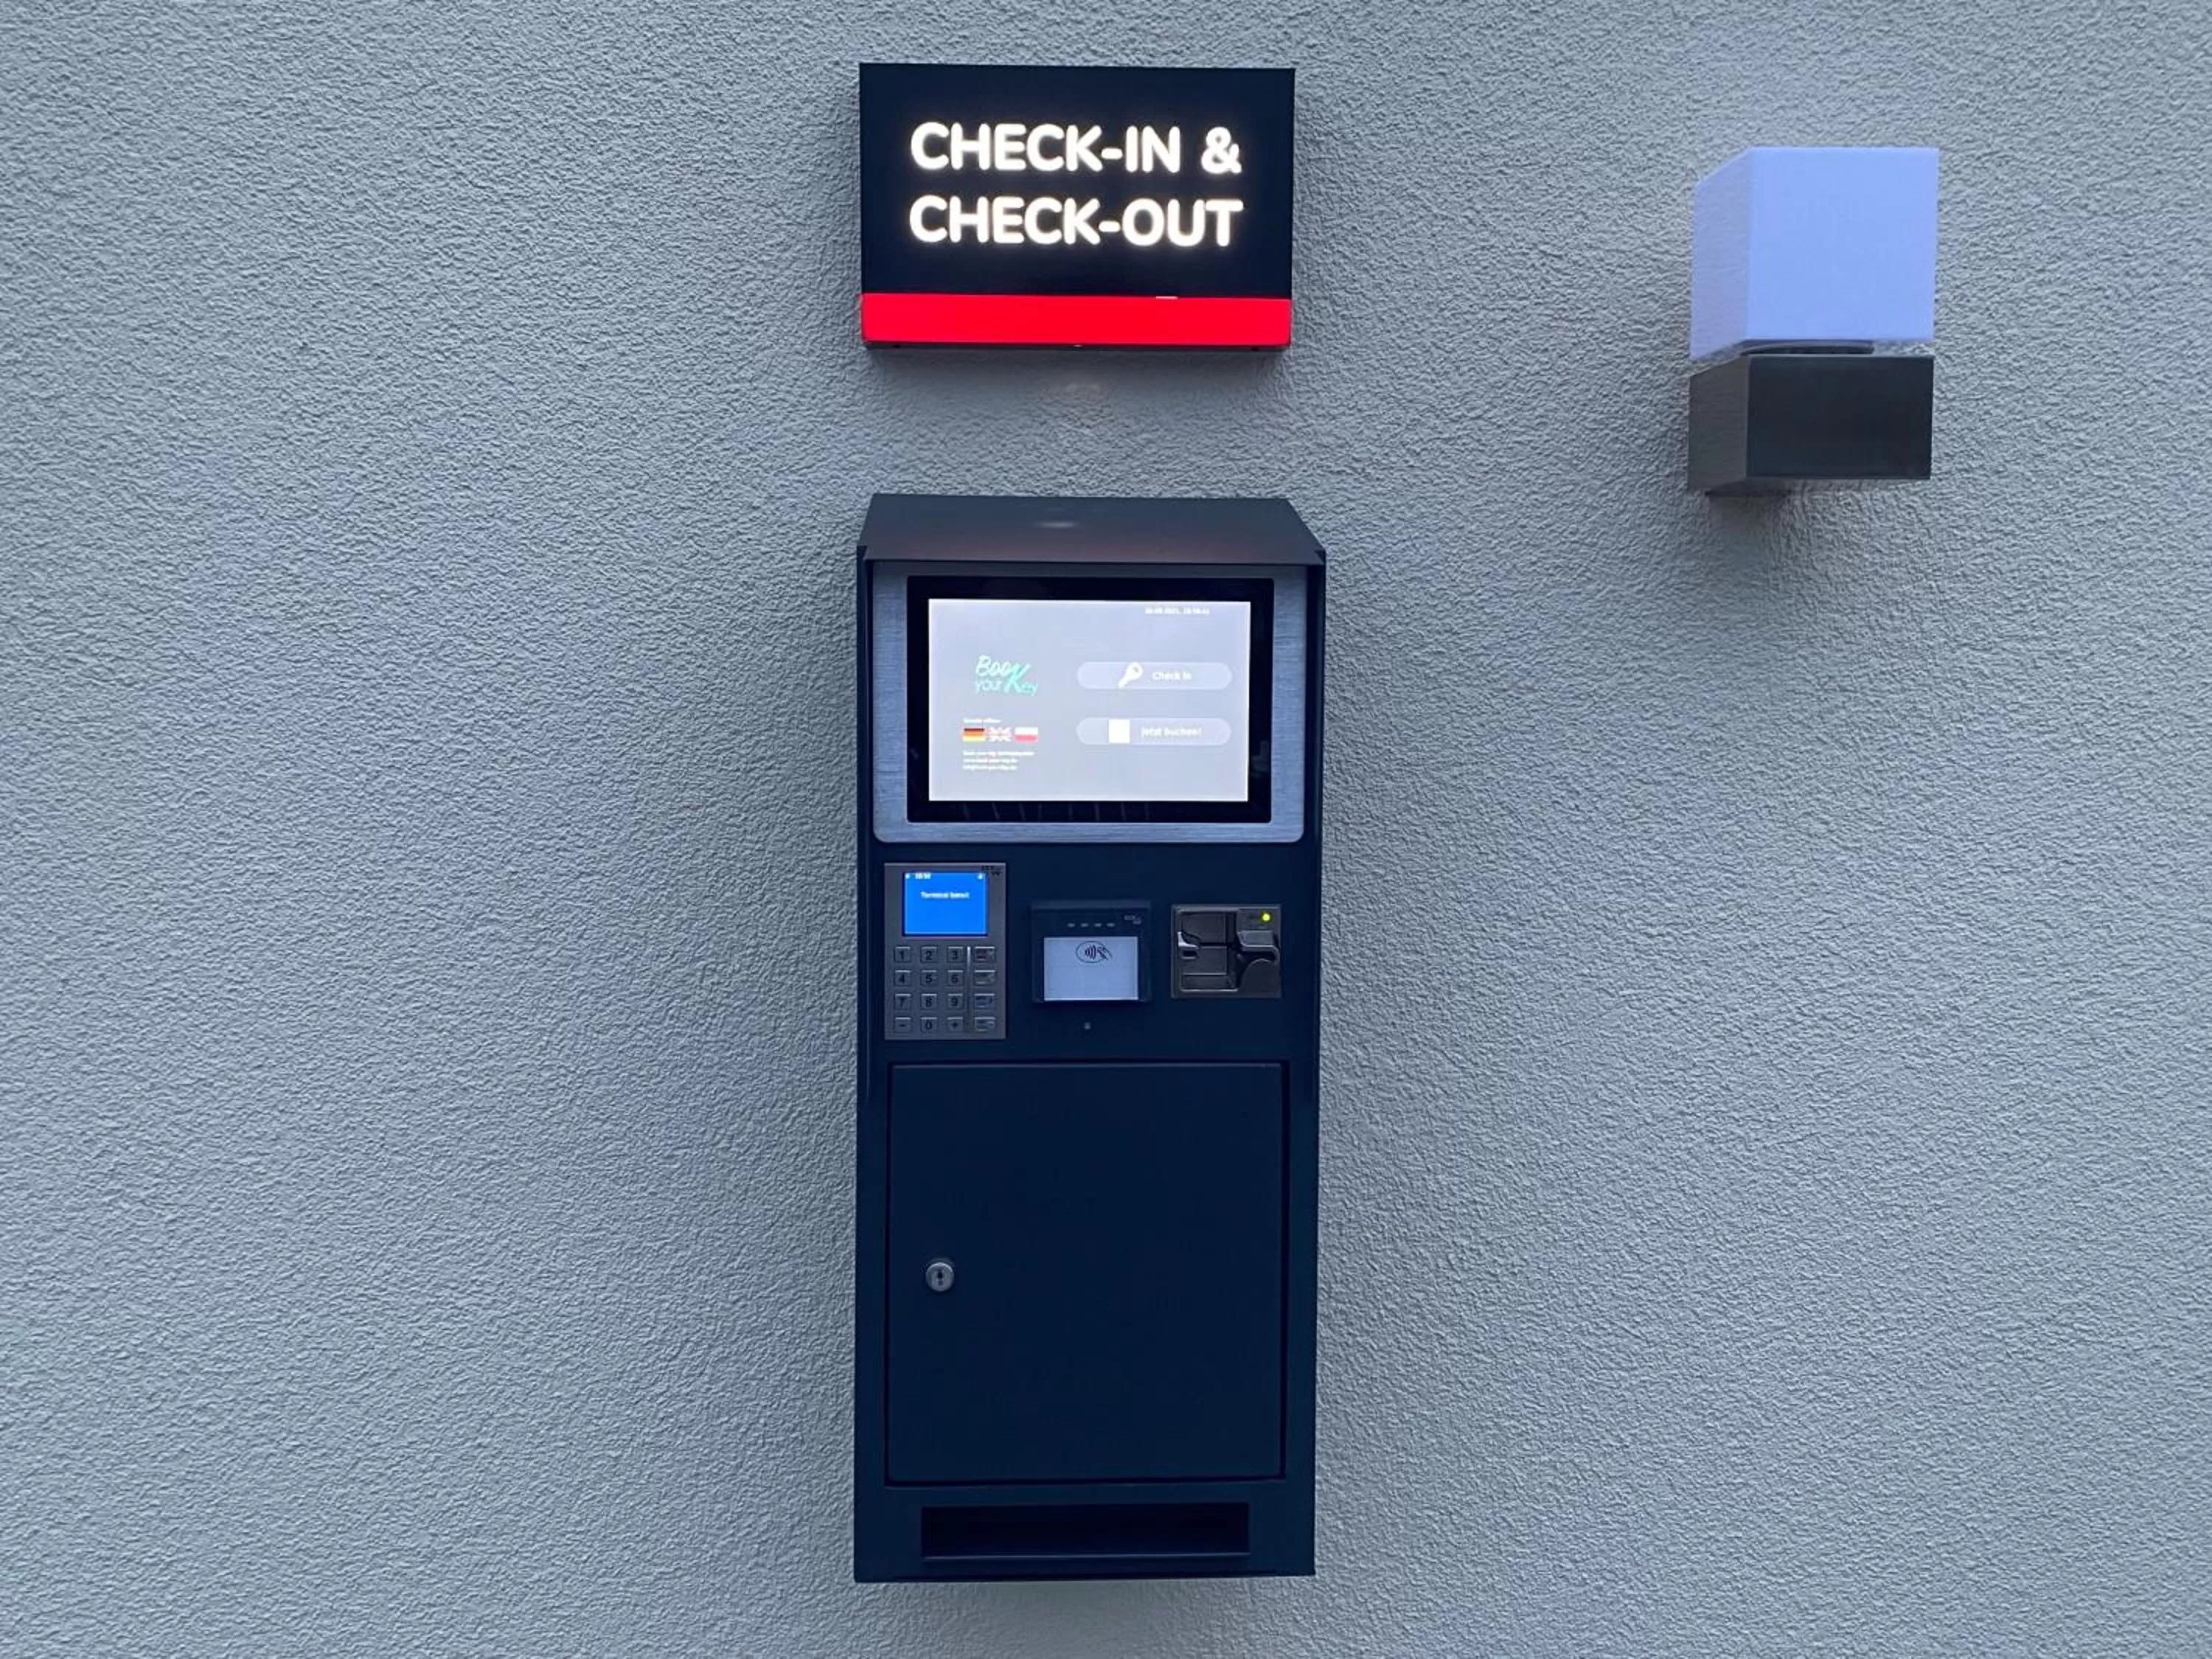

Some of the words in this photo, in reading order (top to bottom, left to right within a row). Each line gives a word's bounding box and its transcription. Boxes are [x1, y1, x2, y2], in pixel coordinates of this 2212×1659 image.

[910, 122, 1180, 173] CHECK-IN
[1200, 126, 1242, 173] &
[909, 195, 1244, 247] CHECK-OUT
[925, 951, 933, 960] 2
[898, 974, 905, 983] 4
